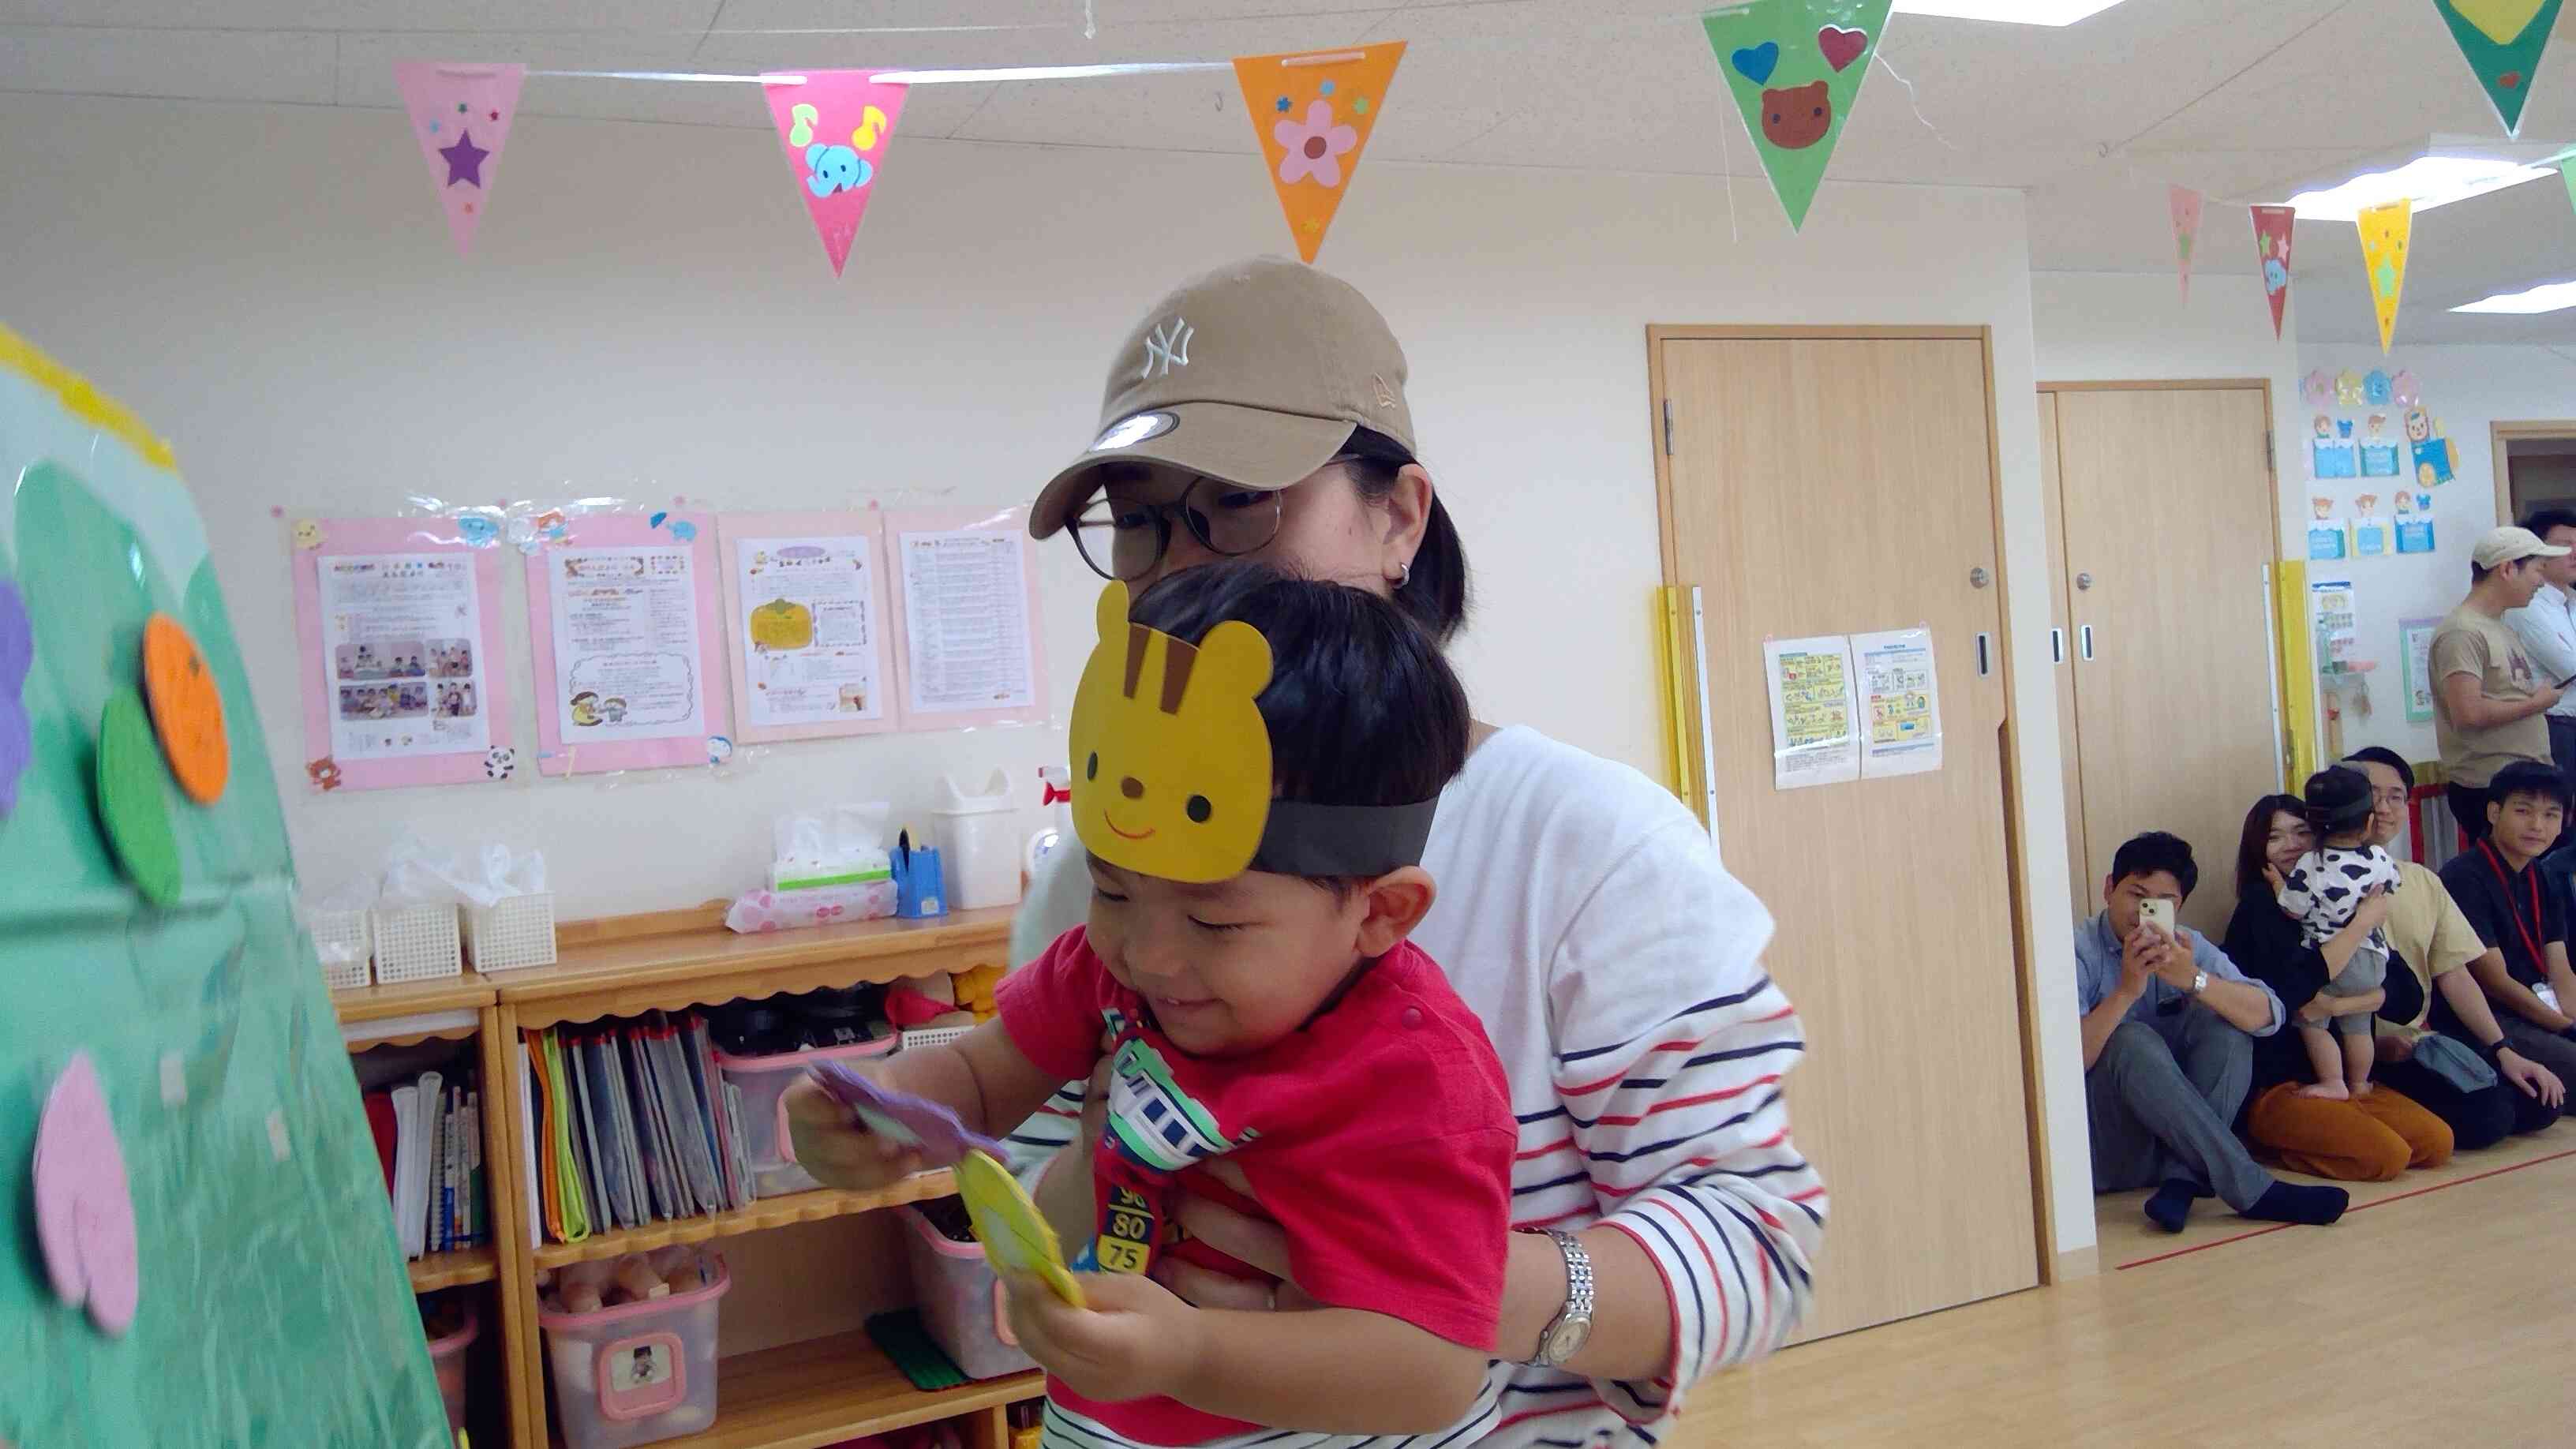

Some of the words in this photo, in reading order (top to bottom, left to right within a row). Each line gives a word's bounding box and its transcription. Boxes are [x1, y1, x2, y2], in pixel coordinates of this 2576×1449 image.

[1142, 317, 1194, 379] NY
[1113, 1213, 1146, 1239] 80
[1110, 1244, 1139, 1269] 75
